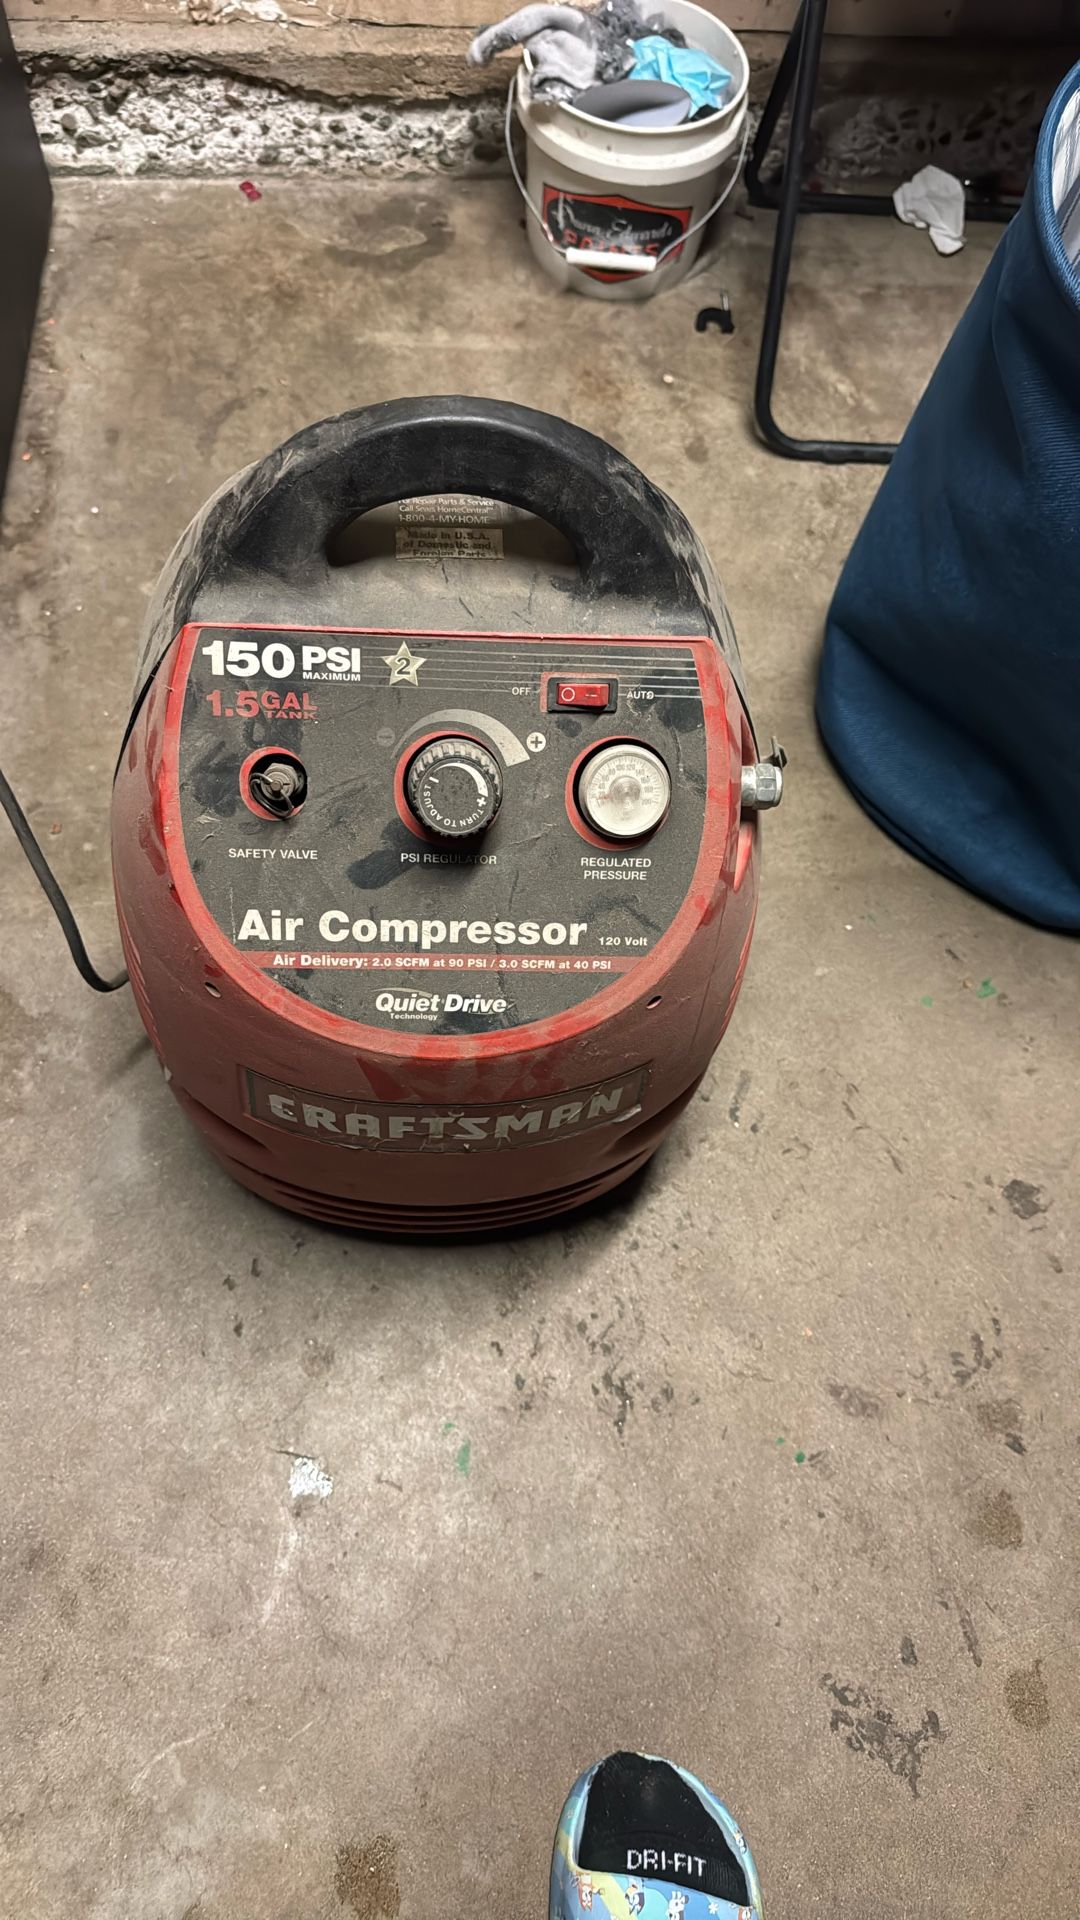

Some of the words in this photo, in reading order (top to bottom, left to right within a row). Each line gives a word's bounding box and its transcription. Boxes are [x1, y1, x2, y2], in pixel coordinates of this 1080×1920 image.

[438, 498, 458, 506] Parts
[467, 498, 495, 507] Service
[418, 540, 469, 549] Domestic
[473, 541, 492, 550] and
[202, 640, 296, 679] 150
[302, 645, 361, 673] PSI
[394, 657, 411, 677] 2
[302, 671, 361, 682] MAXIMUM
[511, 686, 532, 696] OFF
[626, 690, 655, 700] AUTO
[206, 689, 260, 718] 1.5
[261, 689, 318, 711] GAL
[263, 711, 319, 720] TANK
[423, 784, 444, 821] ADJUST
[443, 818, 457, 828] TO
[459, 808, 484, 828] TURN
[228, 848, 276, 859] SAFETY
[279, 849, 318, 860] VALVE
[400, 853, 420, 864] PSI
[423, 853, 497, 865] REGULATOR
[580, 857, 651, 868] REGULATED
[583, 870, 647, 881] PRESSURE
[237, 909, 304, 941] Air
[318, 909, 588, 950] Compressor
[599, 936, 621, 946] 120
[625, 936, 648, 946] Volt
[273, 955, 297, 967] Air
[300, 955, 368, 969] Delivery:
[372, 957, 391, 967] 2.0
[394, 957, 430, 968] SCFM
[433, 958, 446, 968] at
[449, 958, 464, 968] 90
[467, 958, 487, 968] PSI
[499, 959, 518, 969] 3.0
[521, 959, 555, 970] SCFM
[558, 960, 571, 970] at
[573, 961, 589, 970] 40
[592, 961, 612, 970] PSI
[375, 992, 440, 1013] Quiet
[444, 993, 507, 1013] Drive
[390, 1012, 438, 1021] Technology
[268, 1088, 623, 1141] CRAFTSMAN
[627, 1848, 707, 1877] DRI-FIT
